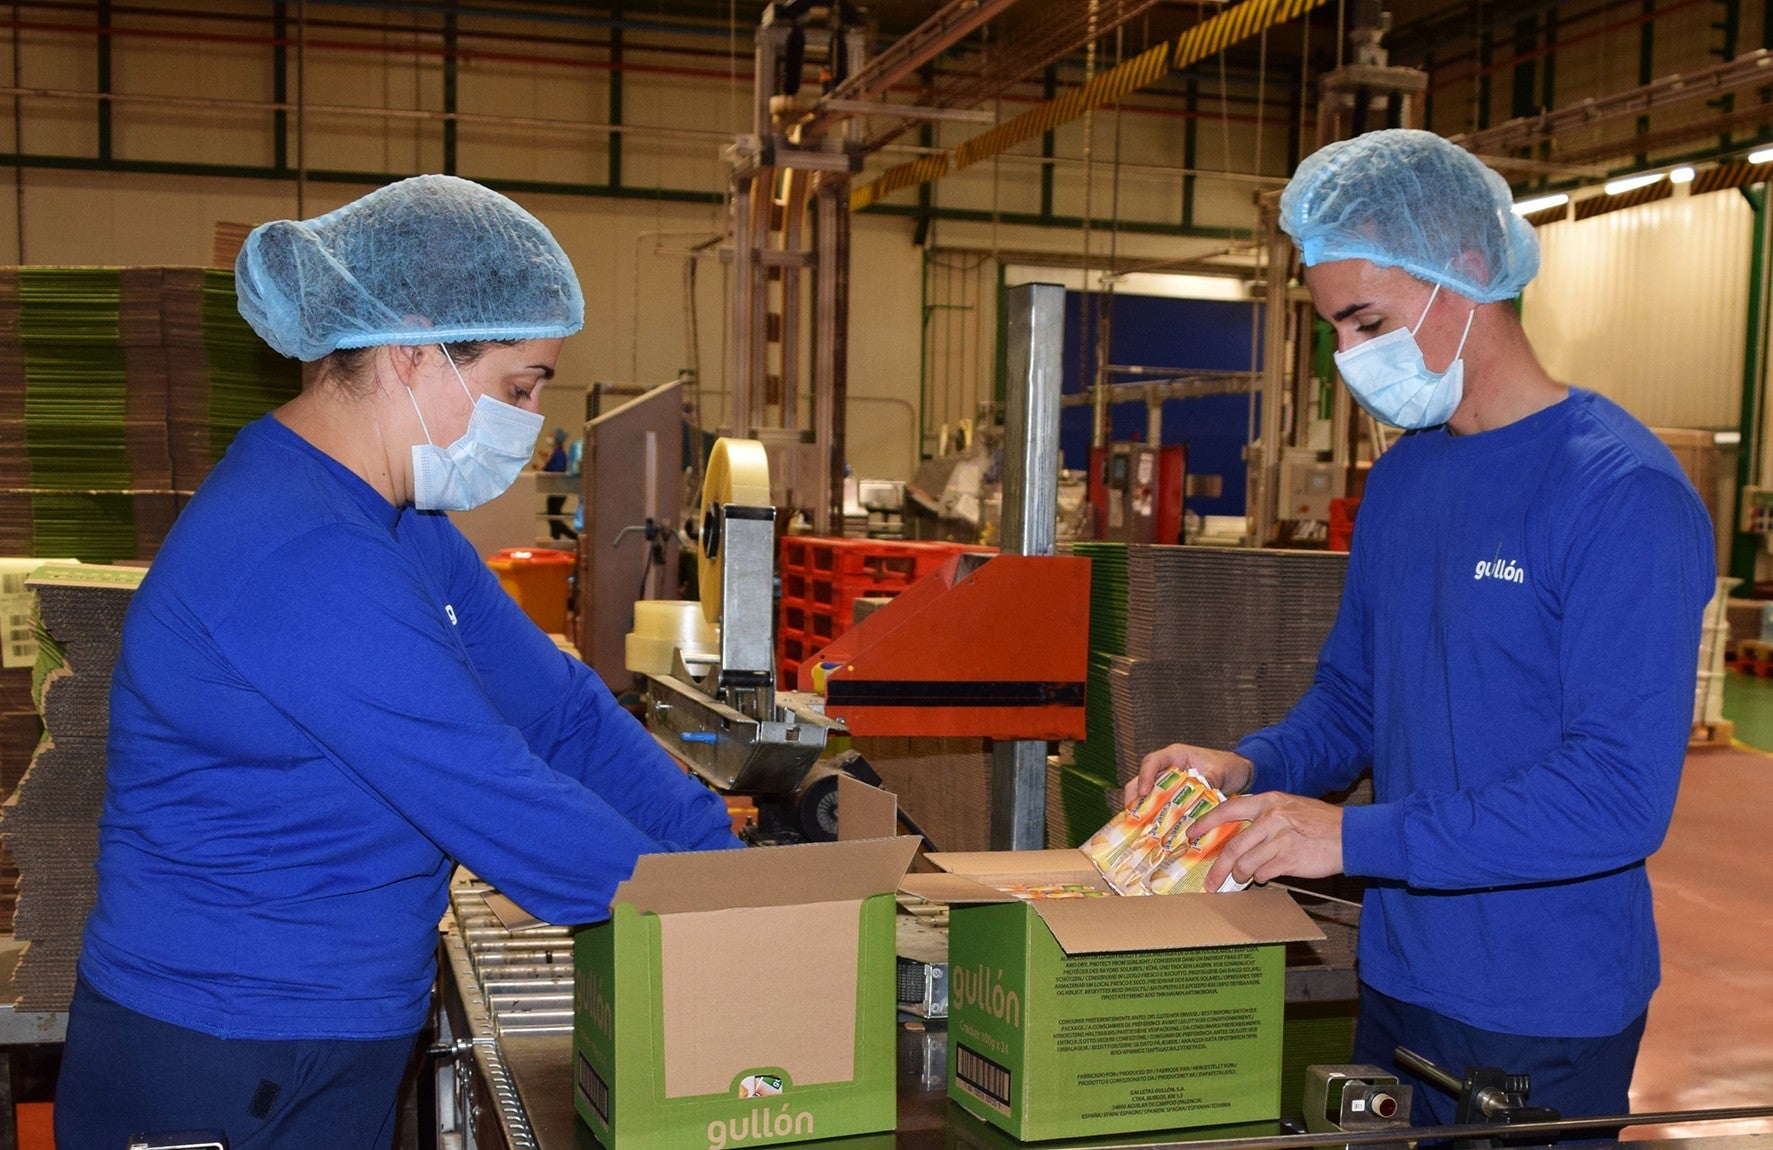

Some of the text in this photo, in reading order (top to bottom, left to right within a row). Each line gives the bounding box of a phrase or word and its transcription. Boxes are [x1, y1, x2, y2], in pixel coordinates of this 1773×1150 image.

[1474, 559, 1524, 583] gullón
[953, 964, 1019, 1028] gullón
[708, 1102, 814, 1150] gullón
